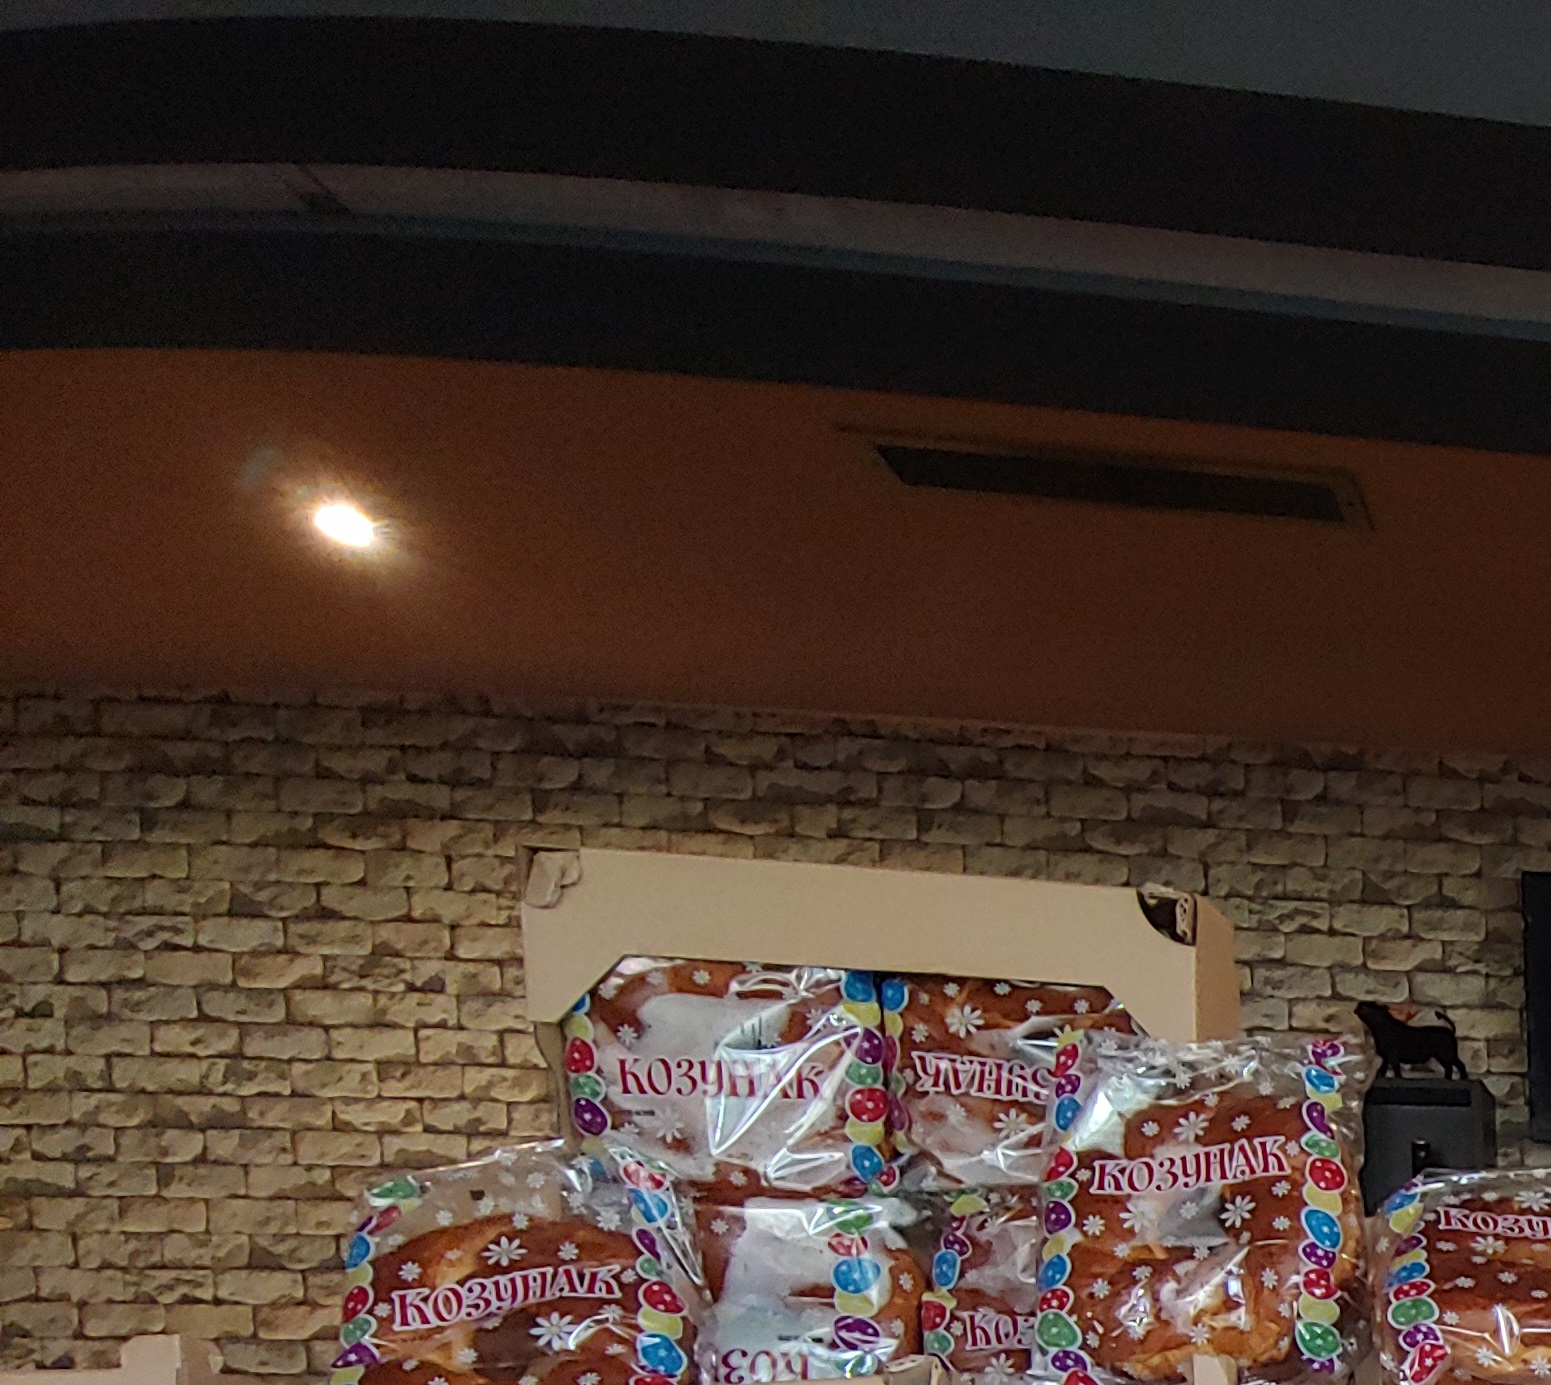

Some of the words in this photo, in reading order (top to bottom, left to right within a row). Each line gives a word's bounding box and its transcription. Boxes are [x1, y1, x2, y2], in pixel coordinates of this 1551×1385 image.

[617, 1054, 828, 1102] КОЗУНК
[1090, 1135, 1292, 1196] КОЗУНАК
[392, 1262, 623, 1331] КОЗУНАК
